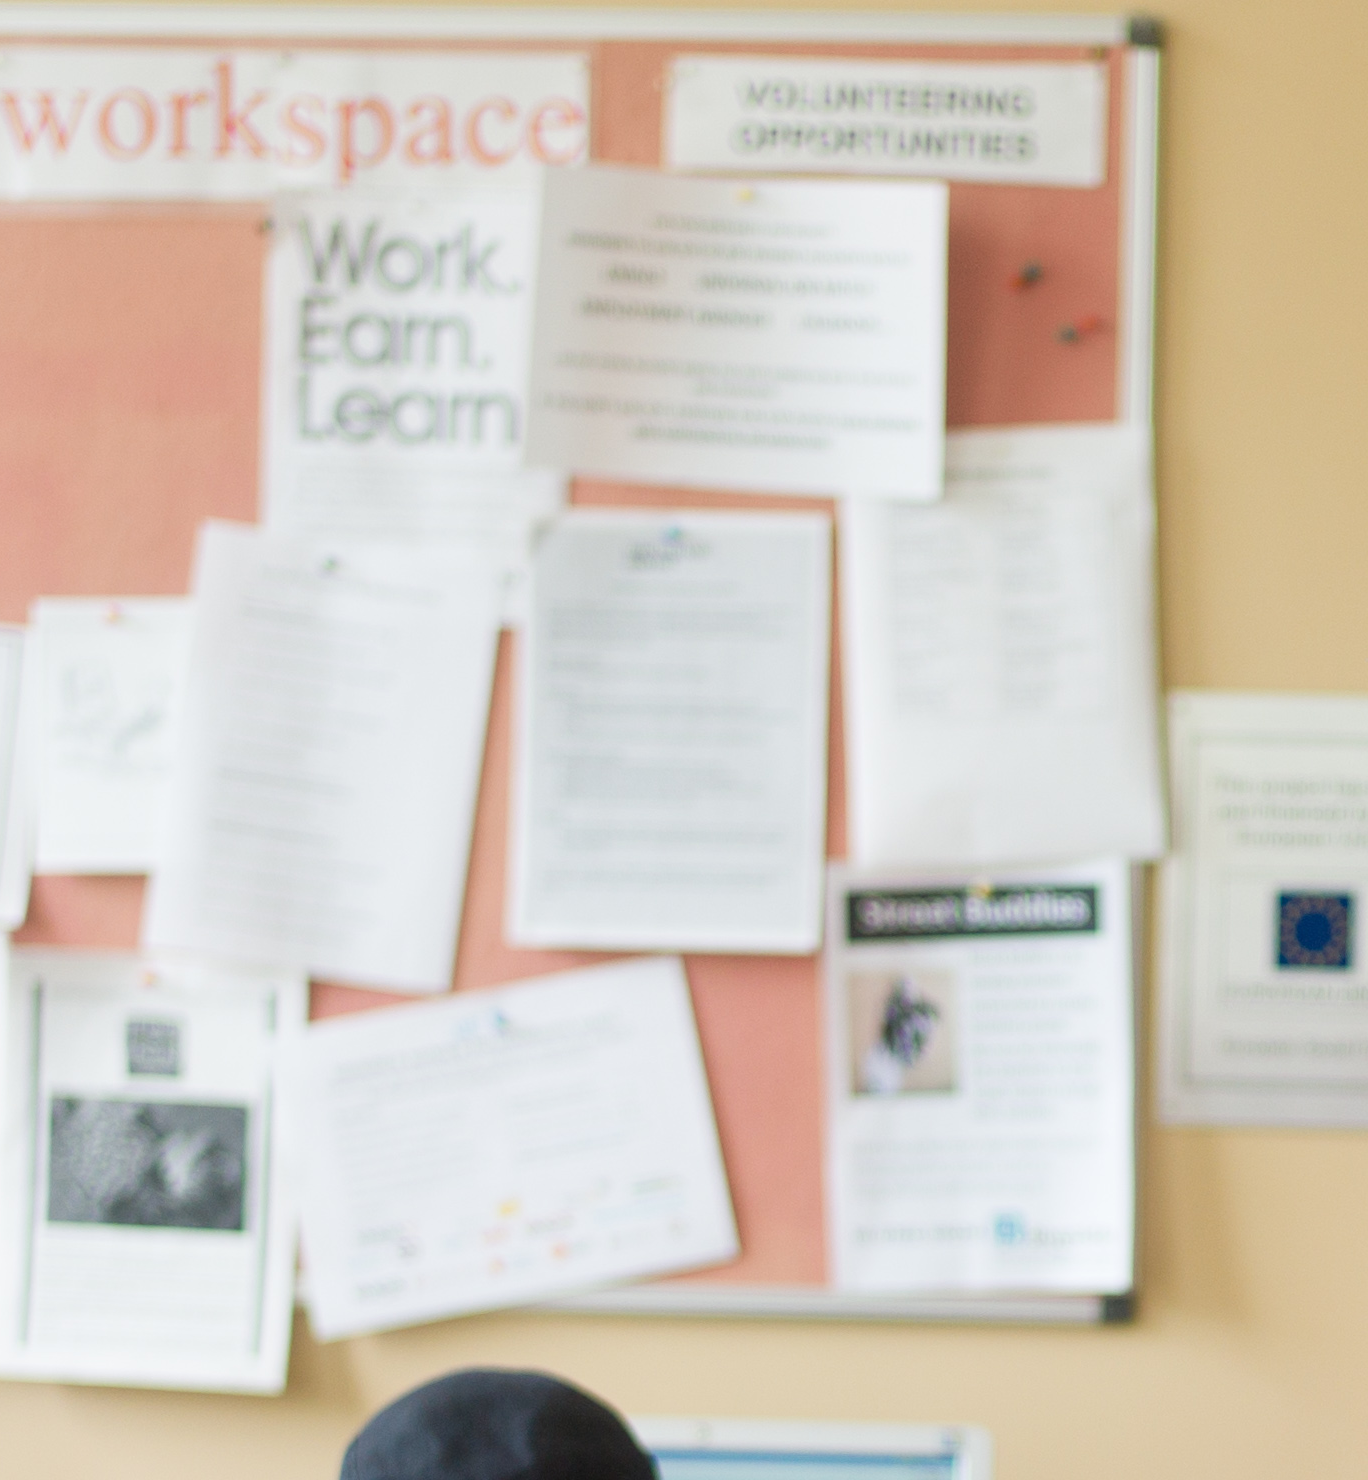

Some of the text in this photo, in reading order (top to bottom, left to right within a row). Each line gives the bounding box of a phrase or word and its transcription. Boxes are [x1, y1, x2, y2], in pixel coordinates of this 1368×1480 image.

[0, 58, 587, 182] workspace
[738, 80, 1035, 117] VOLUNTEERING
[733, 124, 1036, 160] OPPORTUNITIES
[297, 217, 522, 294] Work.
[297, 296, 491, 371] Earn.
[297, 375, 520, 448] Learn
